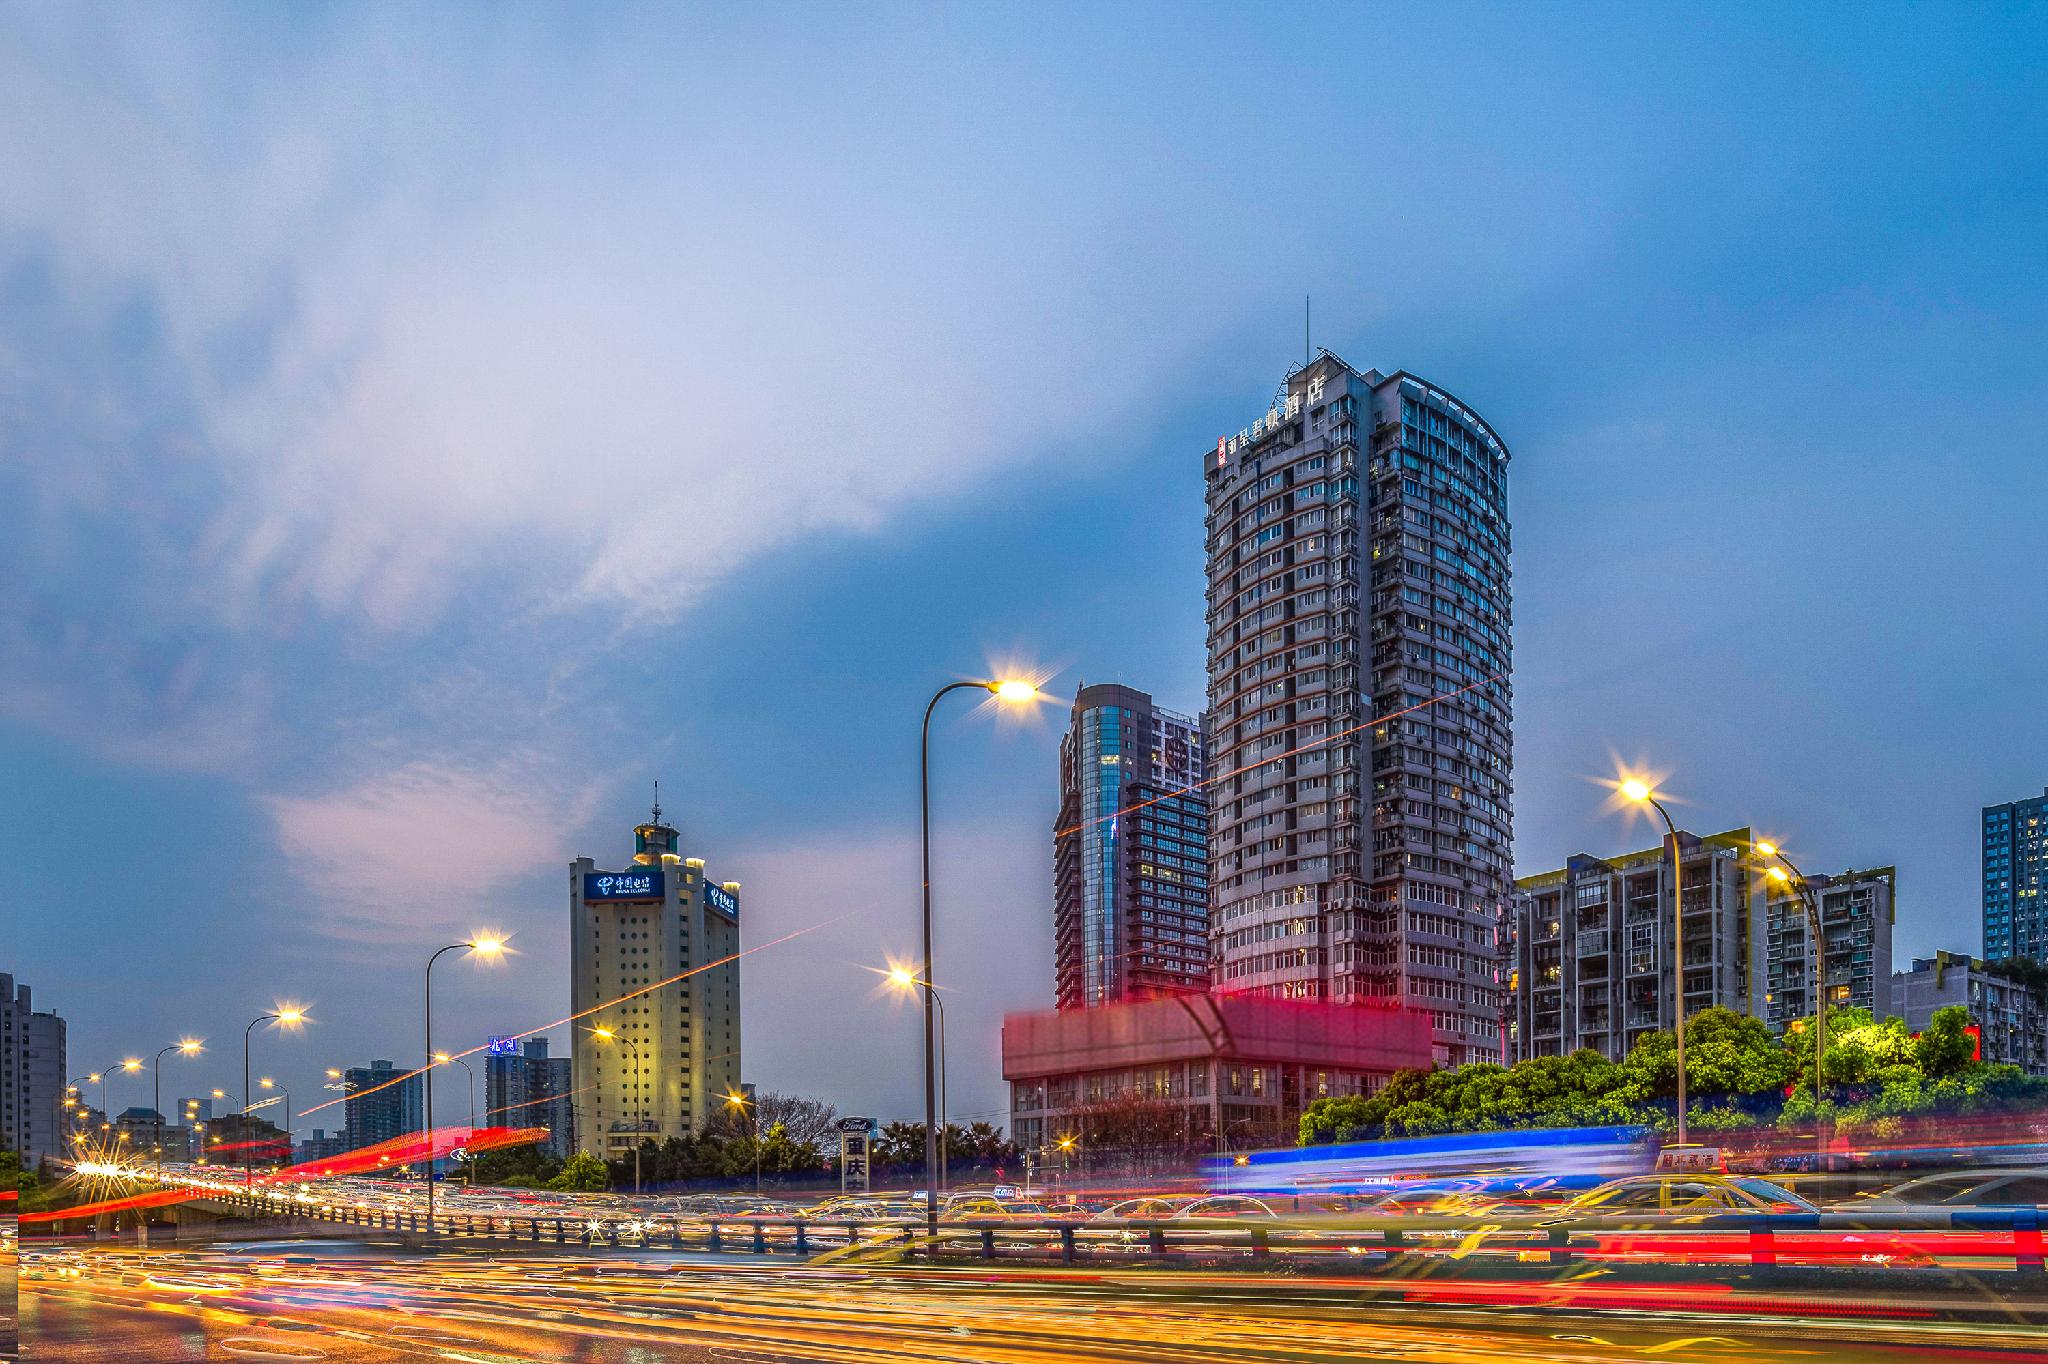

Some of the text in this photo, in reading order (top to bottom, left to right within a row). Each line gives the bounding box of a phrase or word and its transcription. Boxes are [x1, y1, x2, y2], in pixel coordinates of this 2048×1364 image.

[616, 876, 650, 889] 中国电信
[843, 1119, 867, 1130] Ford
